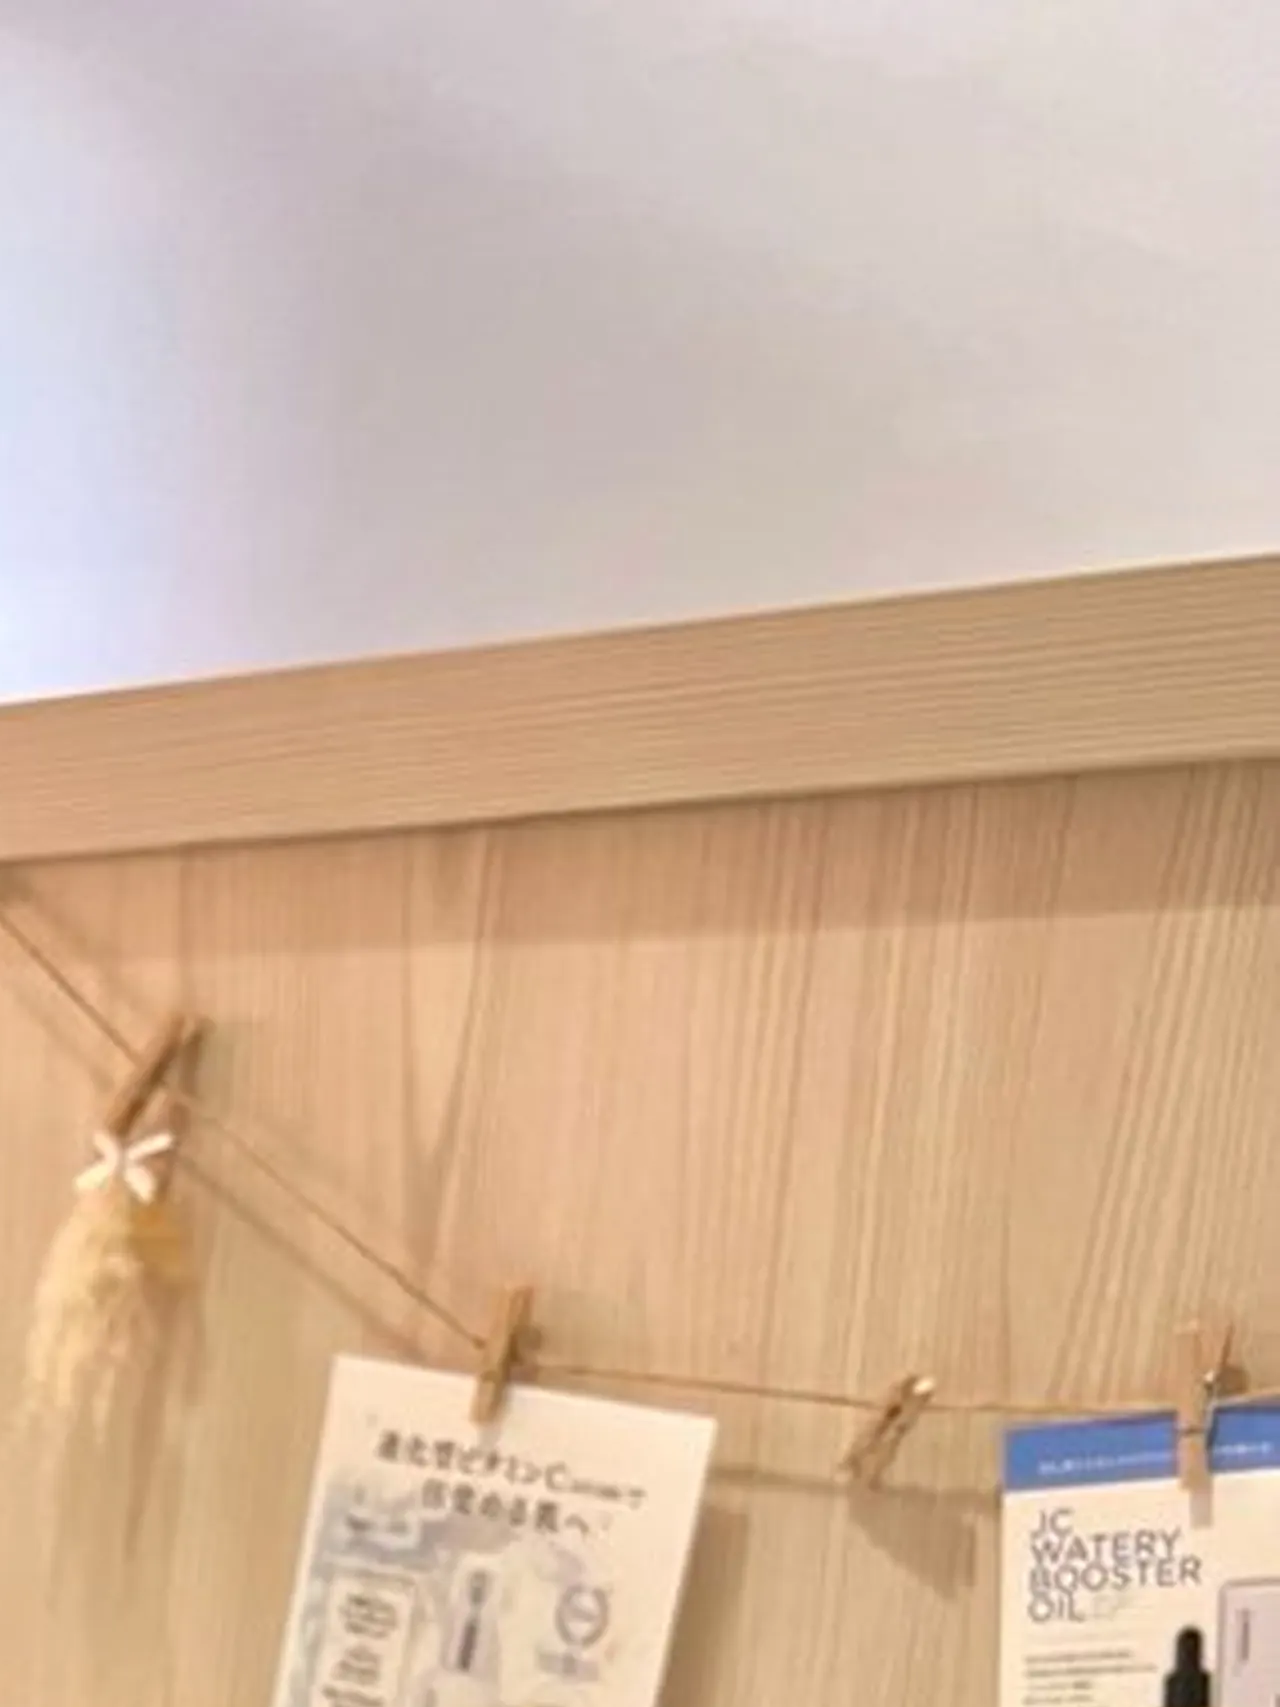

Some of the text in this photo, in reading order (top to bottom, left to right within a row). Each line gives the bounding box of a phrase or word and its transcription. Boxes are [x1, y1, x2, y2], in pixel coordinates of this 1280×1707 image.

[1030, 1526, 1182, 1565] WATERY
[1028, 1555, 1203, 1597] BOOSTER
[1027, 1592, 1086, 1623] OIL
